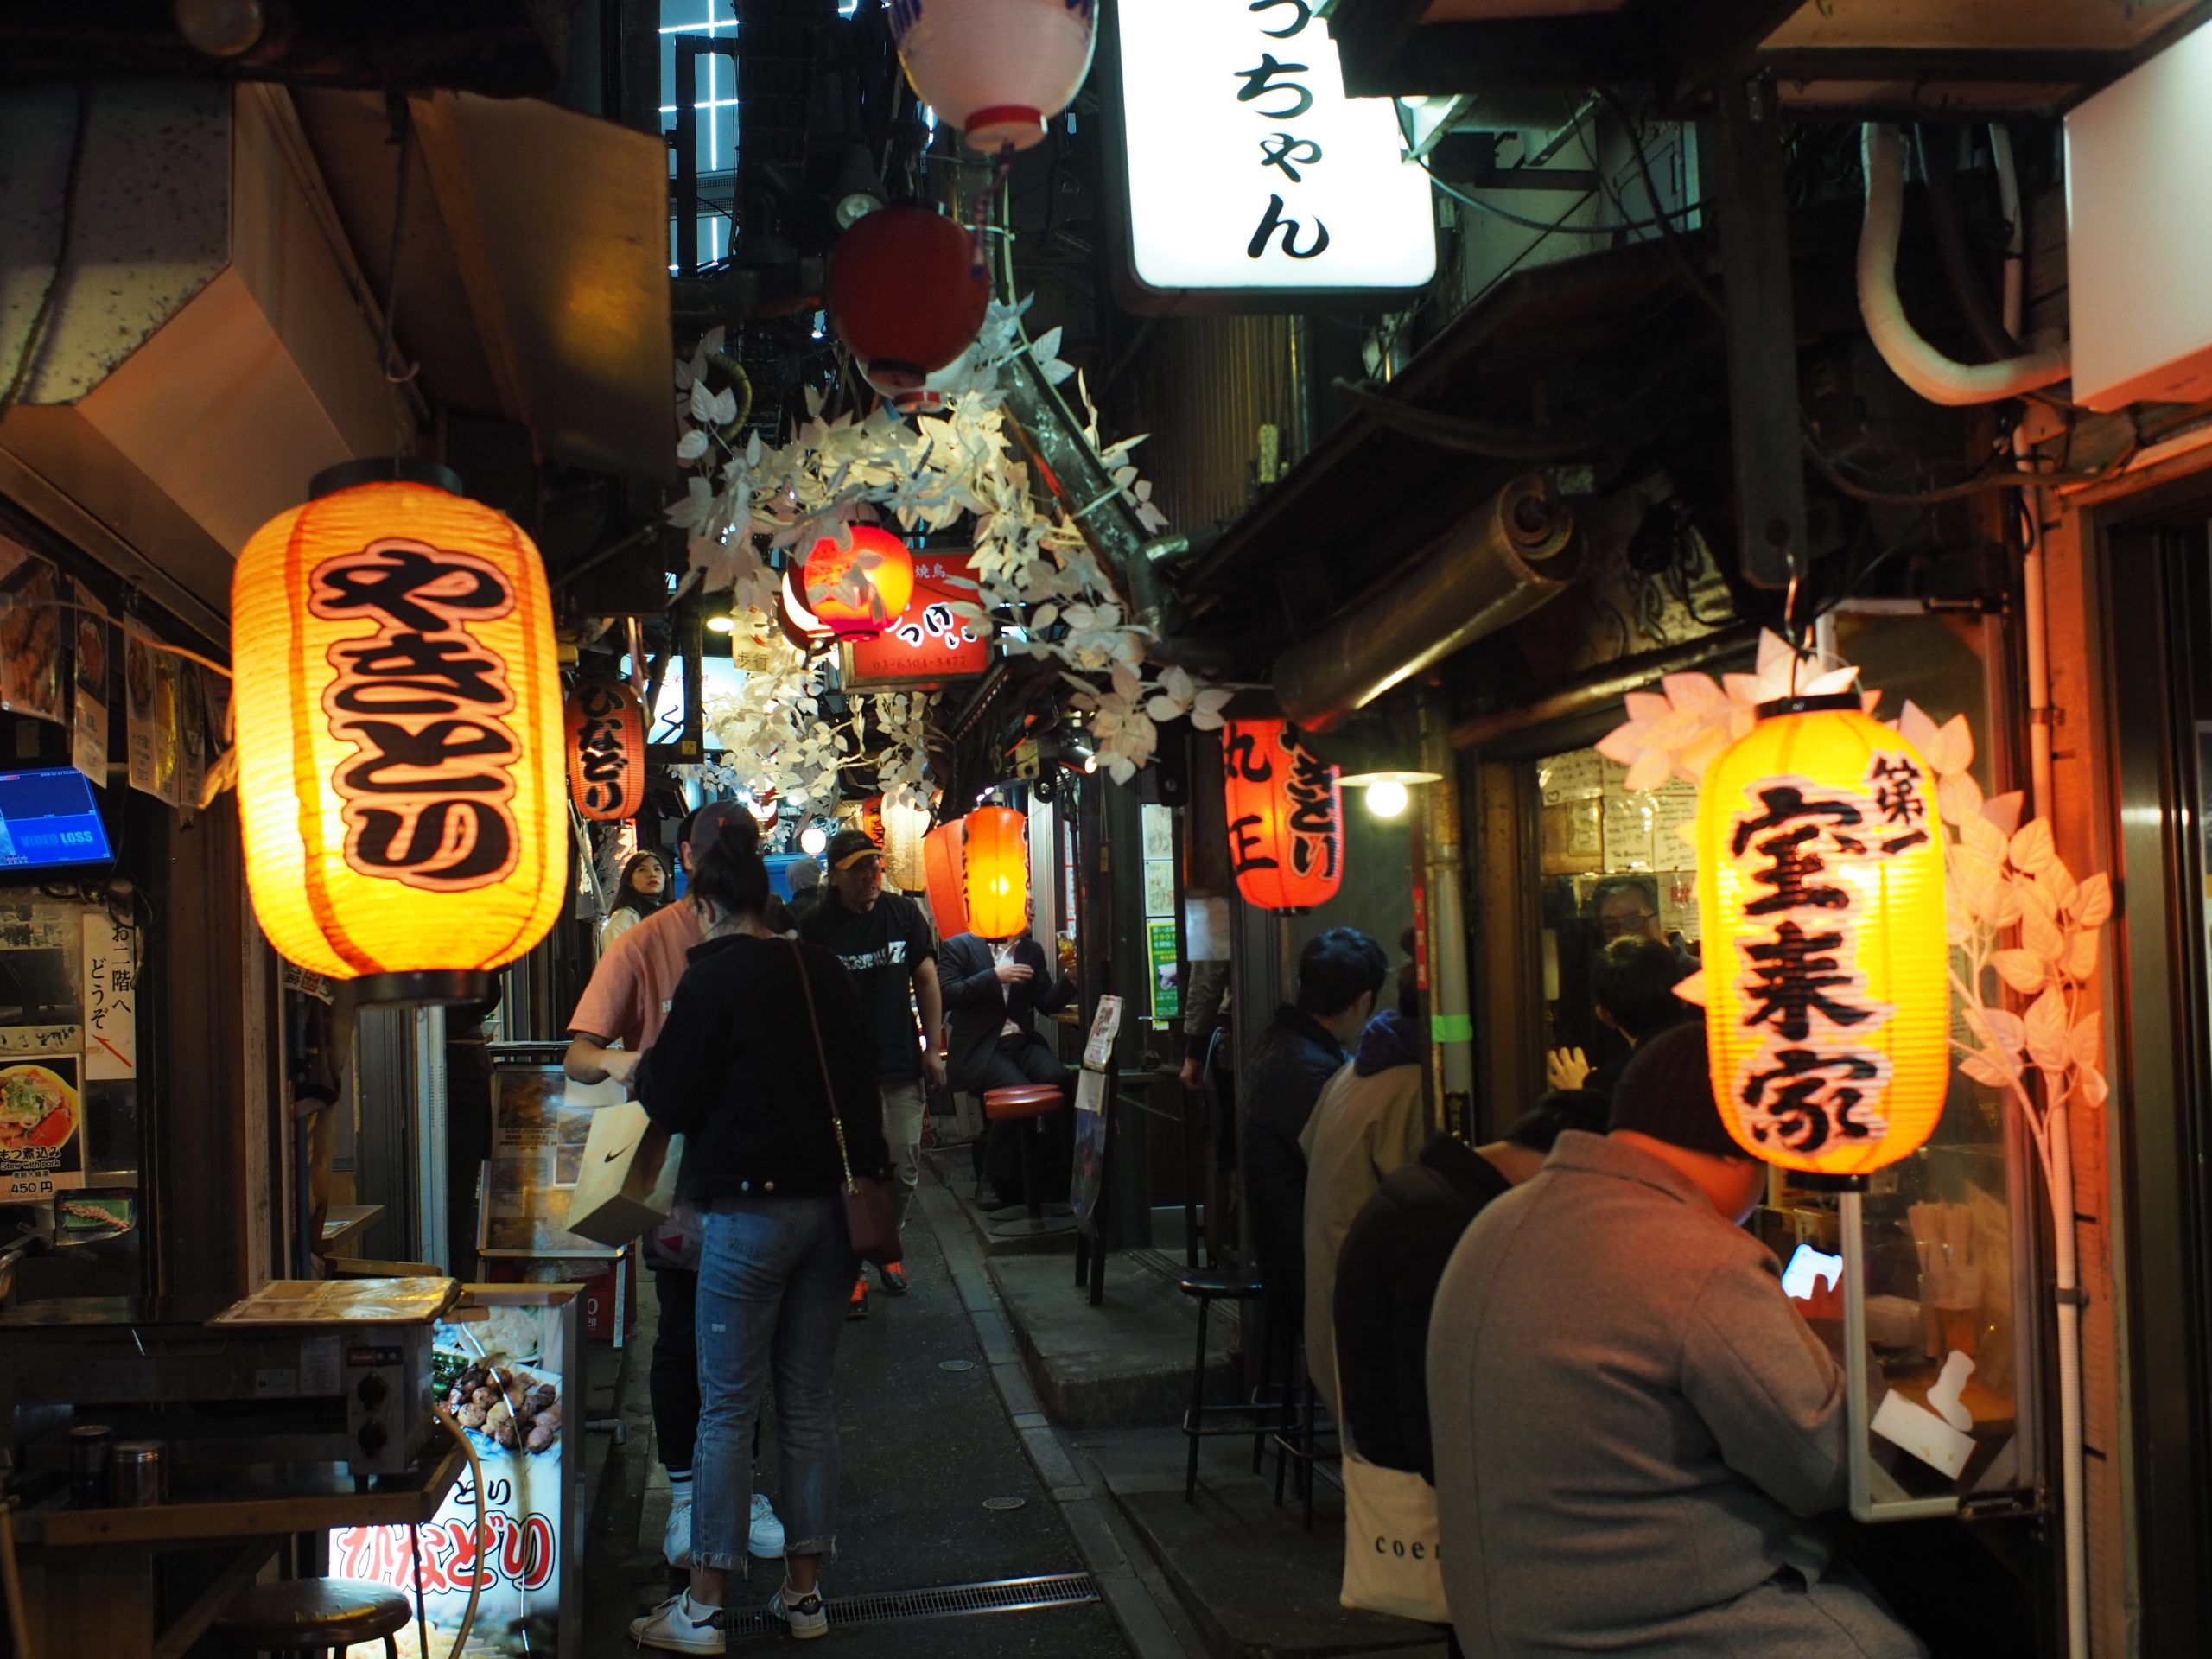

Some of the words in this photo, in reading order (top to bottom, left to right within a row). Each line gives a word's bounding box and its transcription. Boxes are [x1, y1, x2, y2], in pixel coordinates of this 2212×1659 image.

[915, 563, 946, 579] 焼鳥
[320, 546, 515, 881] やきとり
[576, 685, 629, 813] ひなどり
[20, 834, 59, 847] VIDEO
[60, 830, 93, 844] LOSS
[1872, 755, 1929, 855] 第一
[91, 957, 109, 1030] どうぞ
[111, 922, 132, 1014] お二階へ
[1731, 785, 1879, 1153] 宝来家
[0, 1146, 61, 1160] もつ煮込み
[1, 1161, 22, 1171] Stew
[22, 1160, 41, 1169] with
[41, 1159, 61, 1168] pork
[11, 1182, 37, 1193] 450
[41, 1180, 54, 1192] 円
